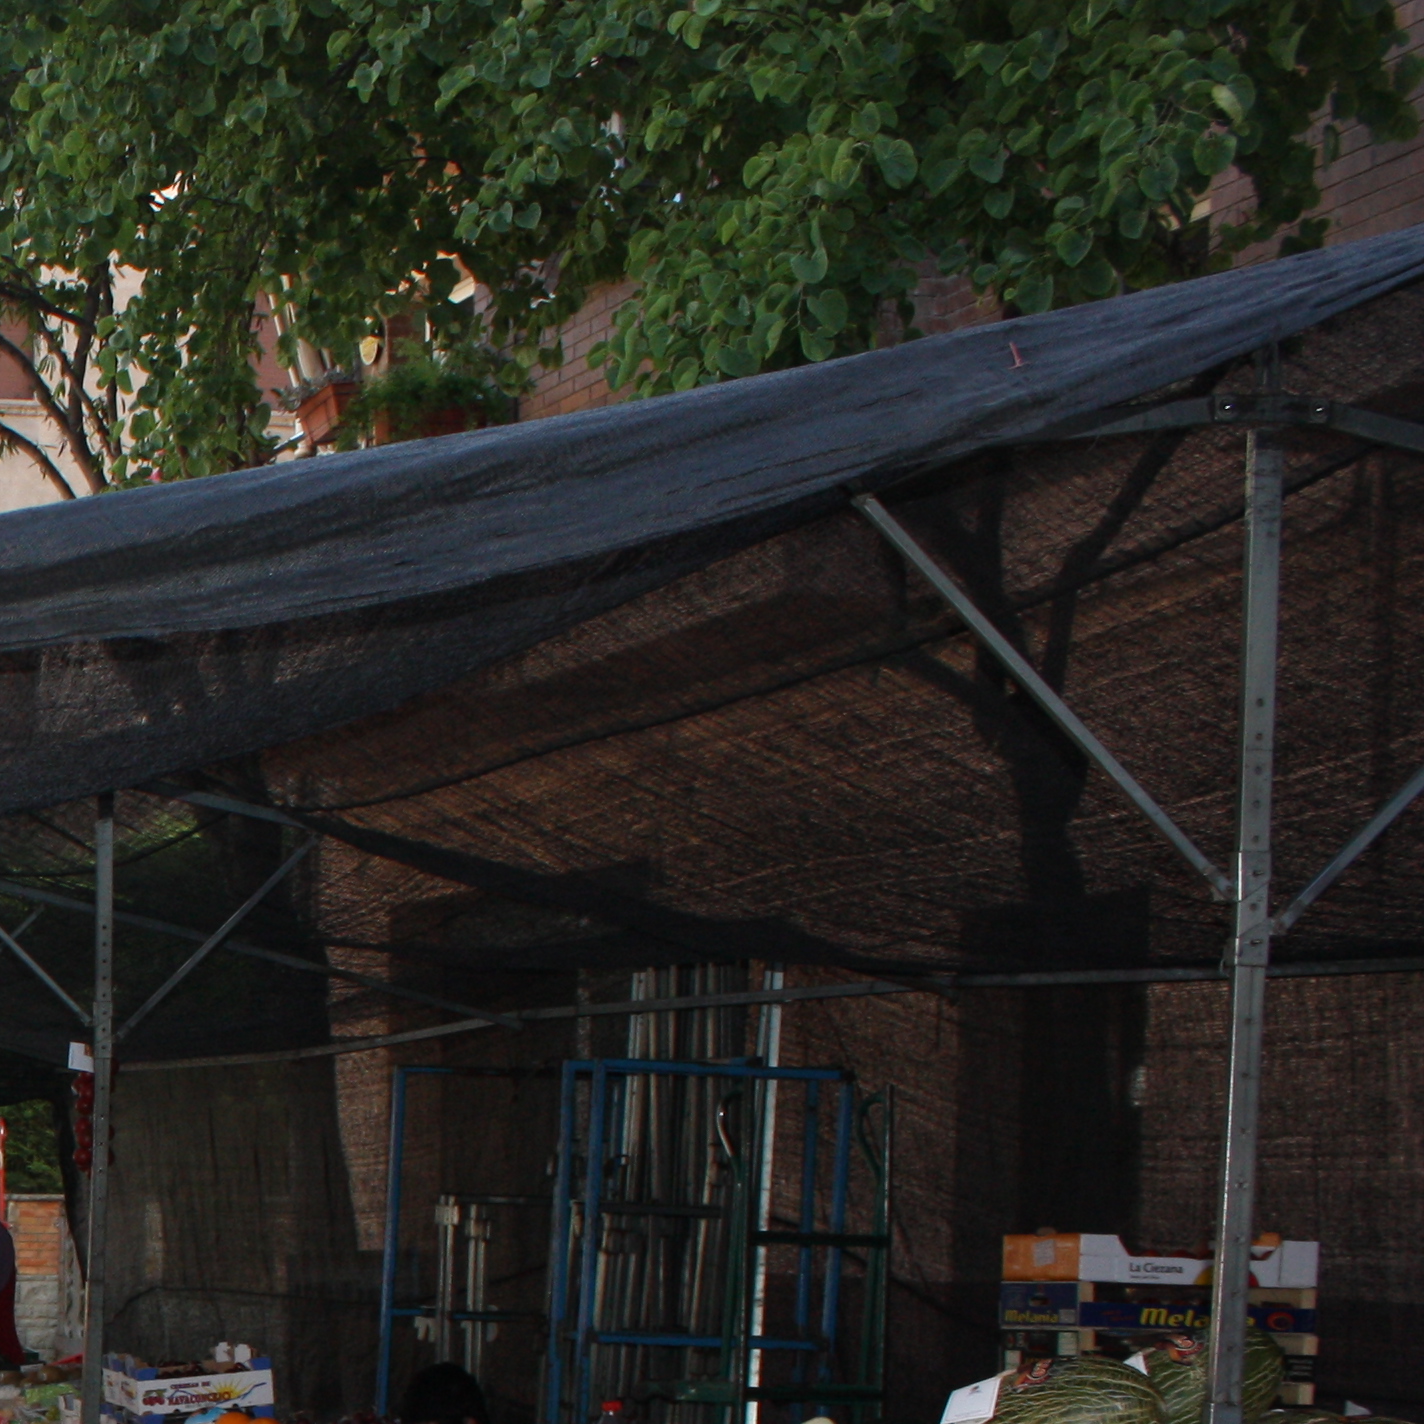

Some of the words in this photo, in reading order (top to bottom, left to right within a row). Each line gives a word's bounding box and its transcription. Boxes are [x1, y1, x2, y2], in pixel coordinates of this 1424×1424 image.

[1129, 1262, 1141, 1272] La
[1143, 1262, 1184, 1274] Ciezana
[1005, 1309, 1059, 1323] Melania
[1139, 1307, 1256, 1328] Melaa
